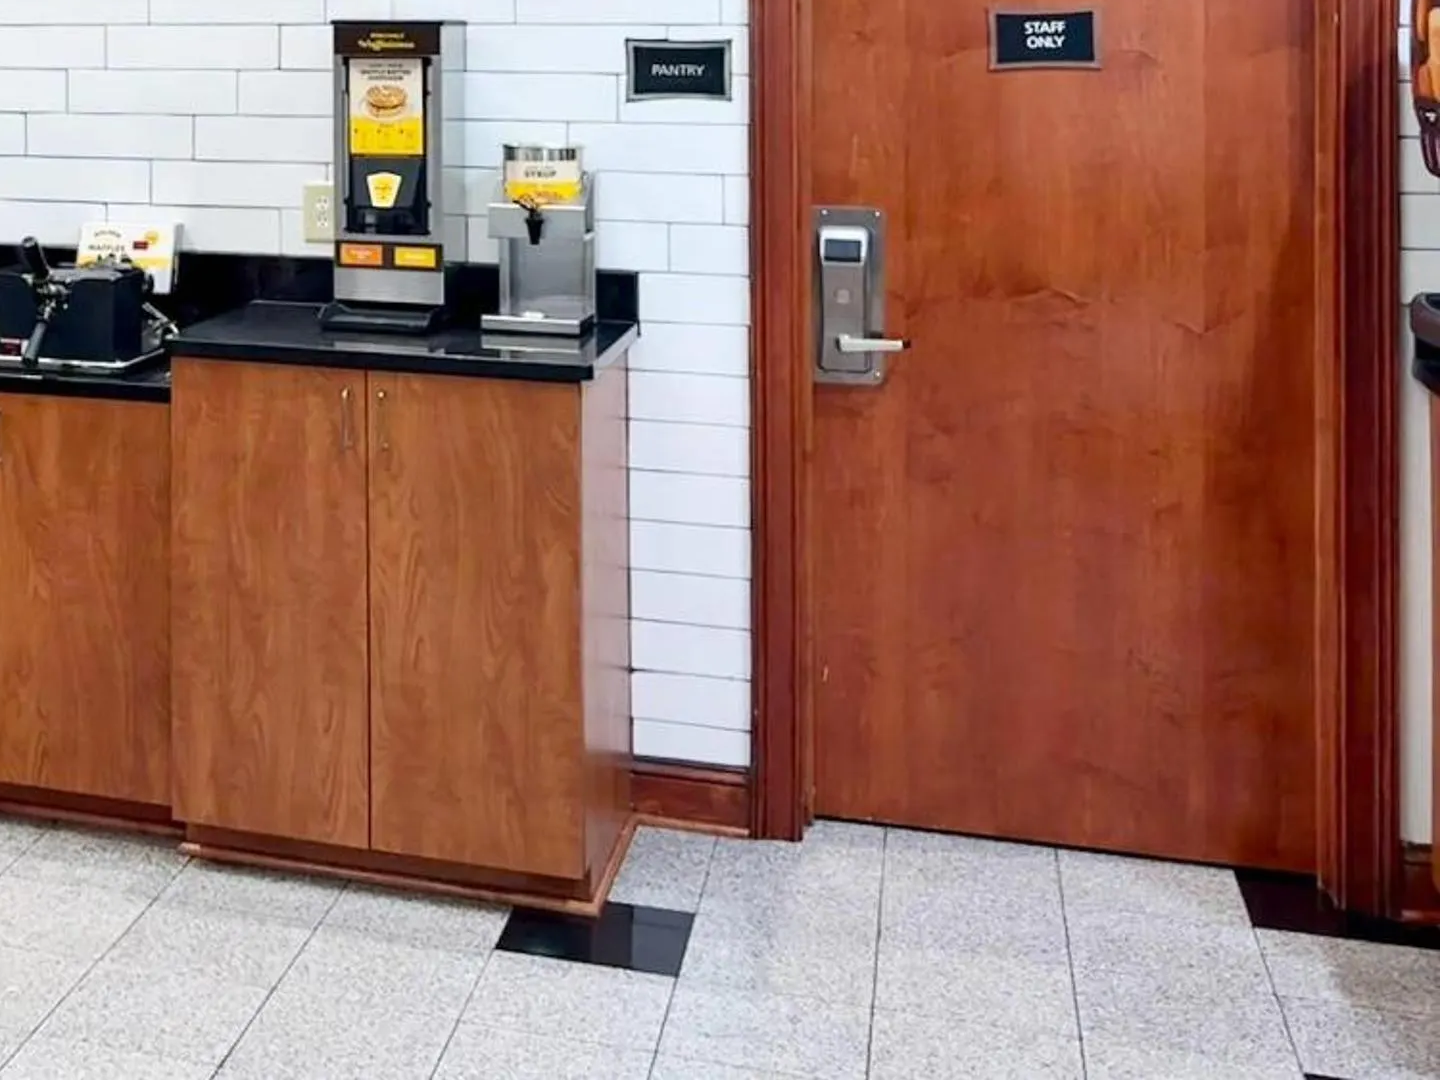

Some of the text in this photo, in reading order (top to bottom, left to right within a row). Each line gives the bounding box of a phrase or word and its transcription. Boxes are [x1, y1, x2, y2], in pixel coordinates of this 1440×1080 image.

[1024, 20, 1066, 35] STAFF
[1026, 35, 1065, 49] ONLY
[651, 63, 706, 77] PANTRY
